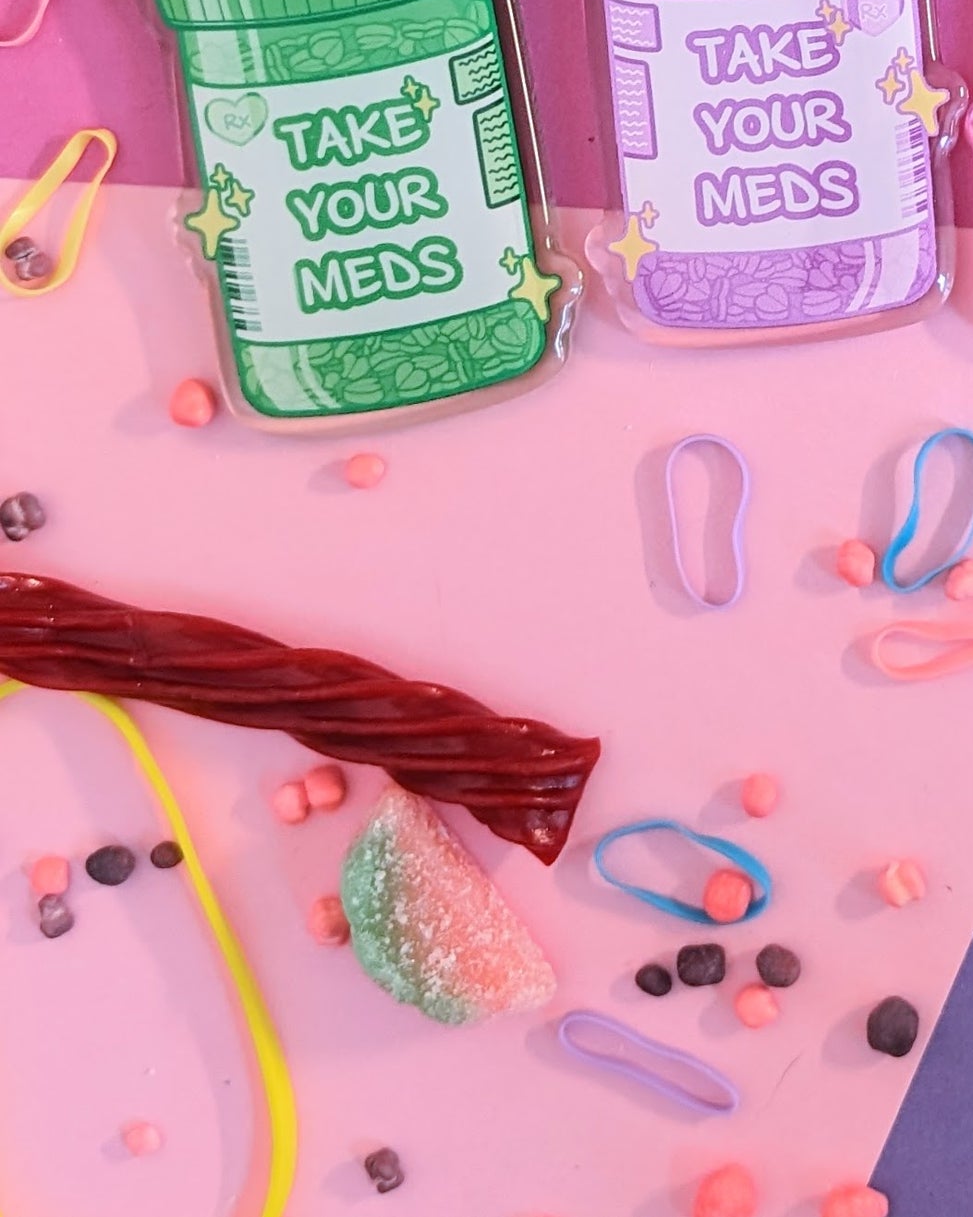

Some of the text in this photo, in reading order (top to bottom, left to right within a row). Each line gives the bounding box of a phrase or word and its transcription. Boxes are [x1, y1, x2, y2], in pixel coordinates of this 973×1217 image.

[689, 25, 837, 83] TAKE
[277, 102, 425, 168] TAKE
[696, 93, 849, 153] YOUR
[287, 171, 443, 238] YOUR
[699, 164, 858, 224] MEDS
[296, 242, 460, 310] MEDS
